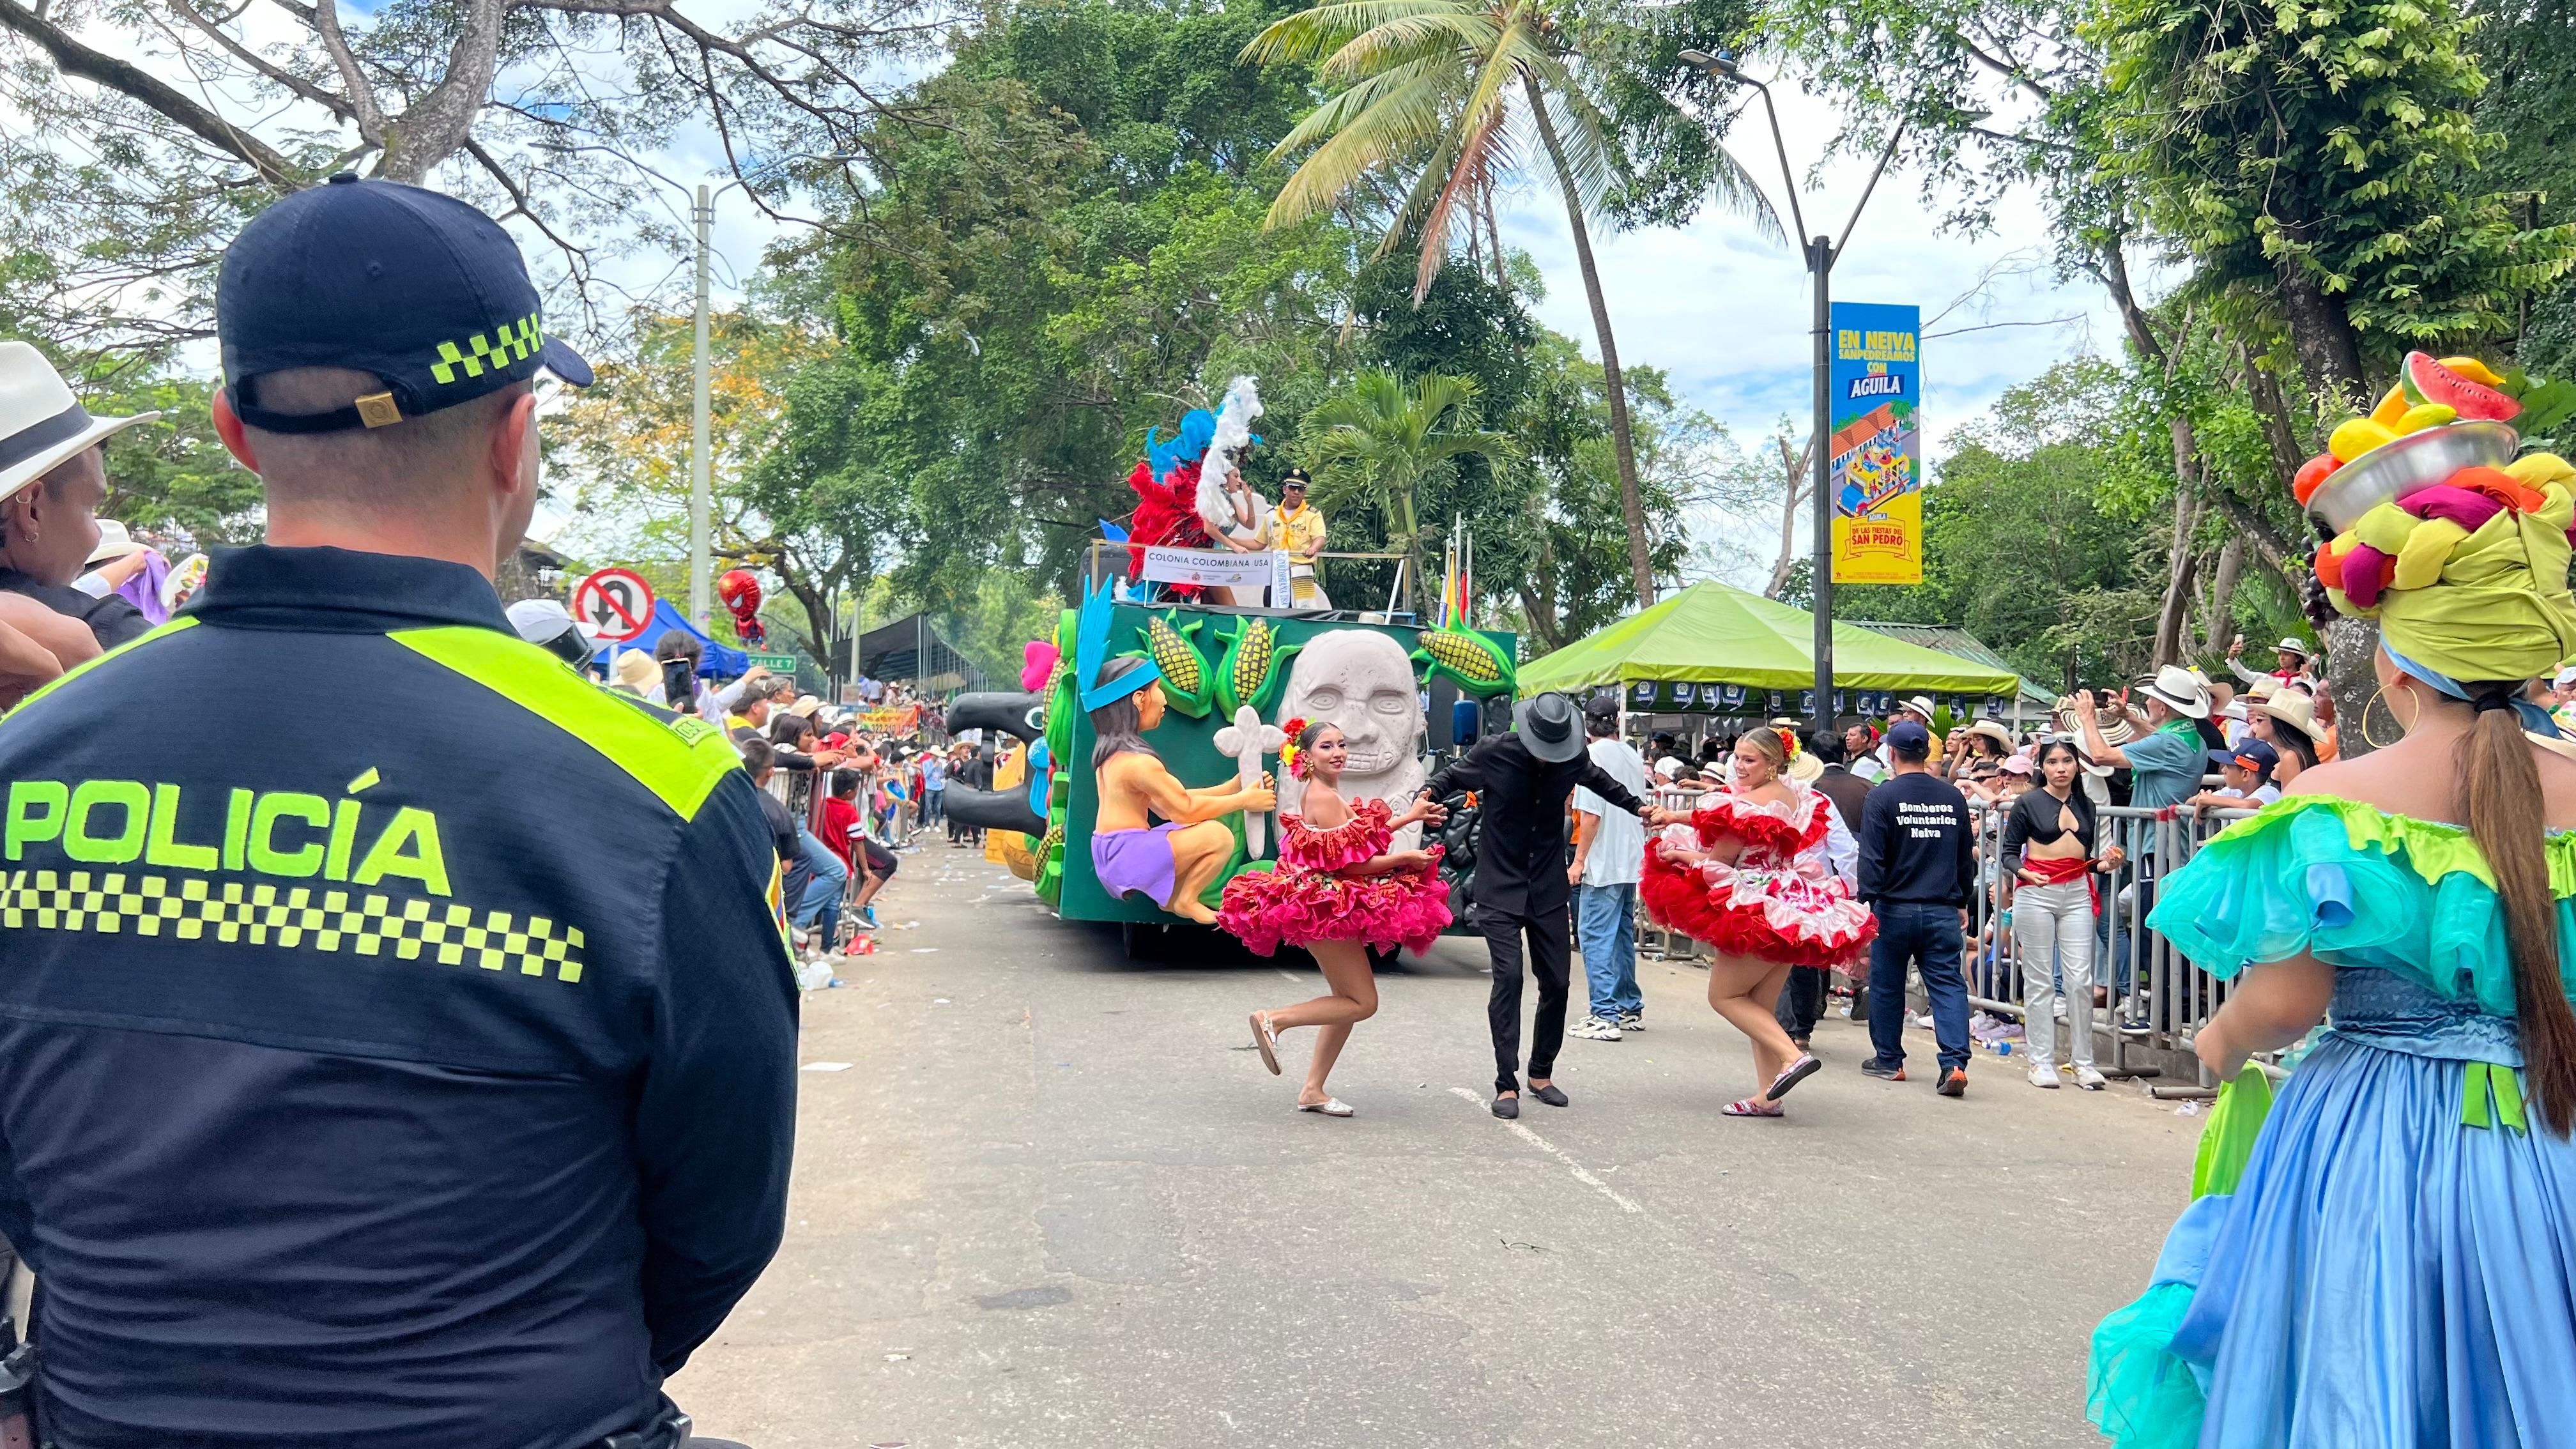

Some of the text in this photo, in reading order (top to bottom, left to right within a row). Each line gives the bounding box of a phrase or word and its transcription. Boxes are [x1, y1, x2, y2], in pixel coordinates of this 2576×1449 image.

[1839, 330, 1915, 351] EN NEIVA
[1839, 349, 1915, 362] SANPEDREAMOS
[1867, 362, 1887, 374] CON
[1850, 376, 1901, 399] AGUILA
[1852, 535, 1903, 546] SAN PEDRO
[1149, 553, 1268, 567] COLONIA COLOMBIANA USA
[750, 658, 783, 668] CALLE
[1899, 802, 1953, 813] Bomberos
[1896, 815, 1957, 825] Voluntarios
[5, 767, 452, 898] POLICÍA
[1911, 828, 1941, 838] Neiva
